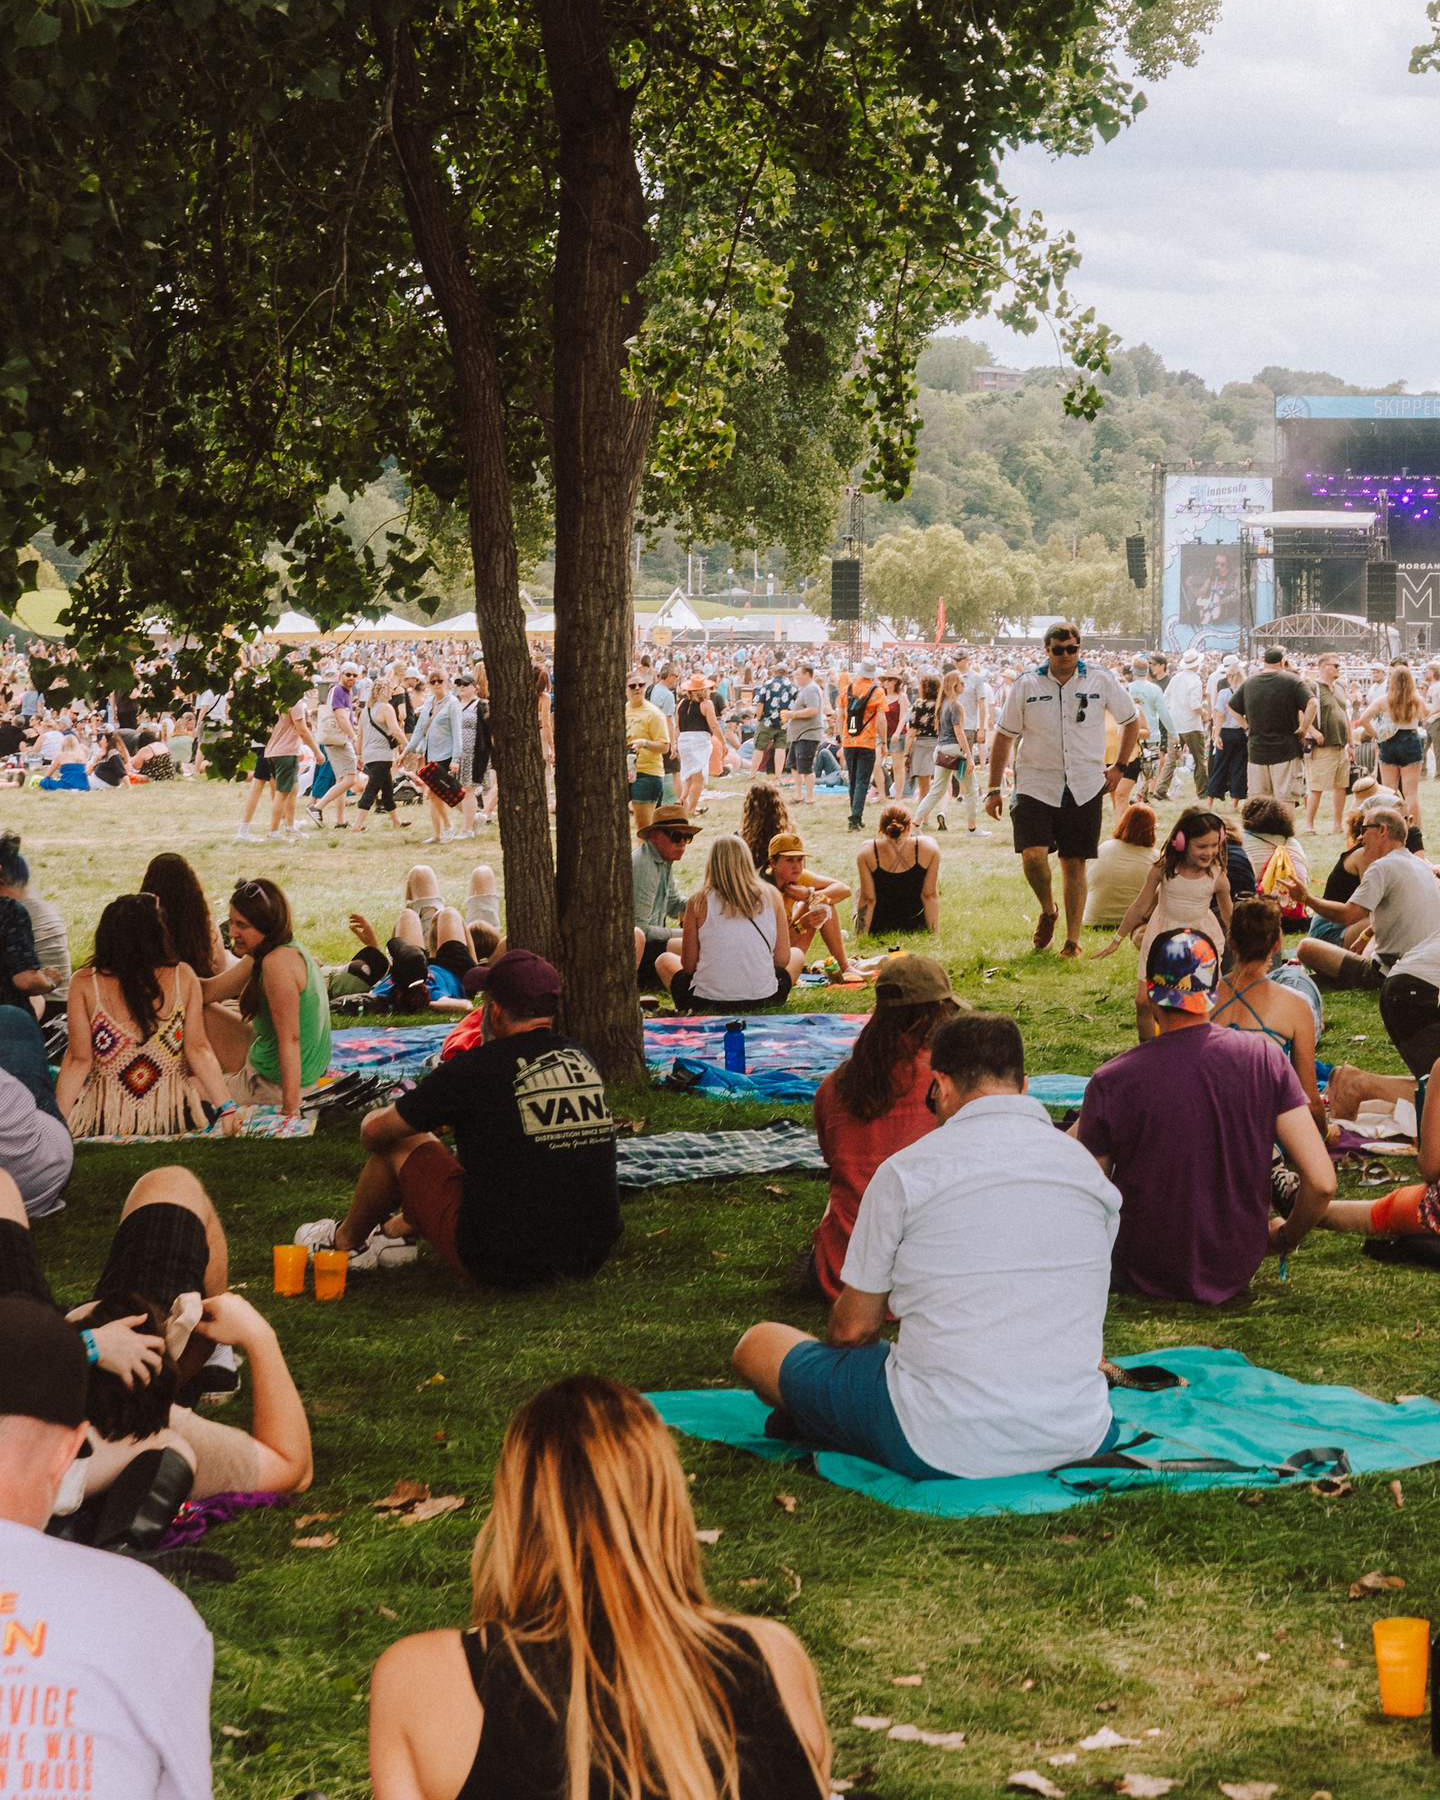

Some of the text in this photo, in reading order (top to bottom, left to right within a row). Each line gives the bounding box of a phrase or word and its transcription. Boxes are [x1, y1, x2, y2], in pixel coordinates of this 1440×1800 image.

[1189, 483, 1247, 504] Minnesota
[0, 1684, 79, 1727] VICE
[46, 1733, 94, 1762] WAR
